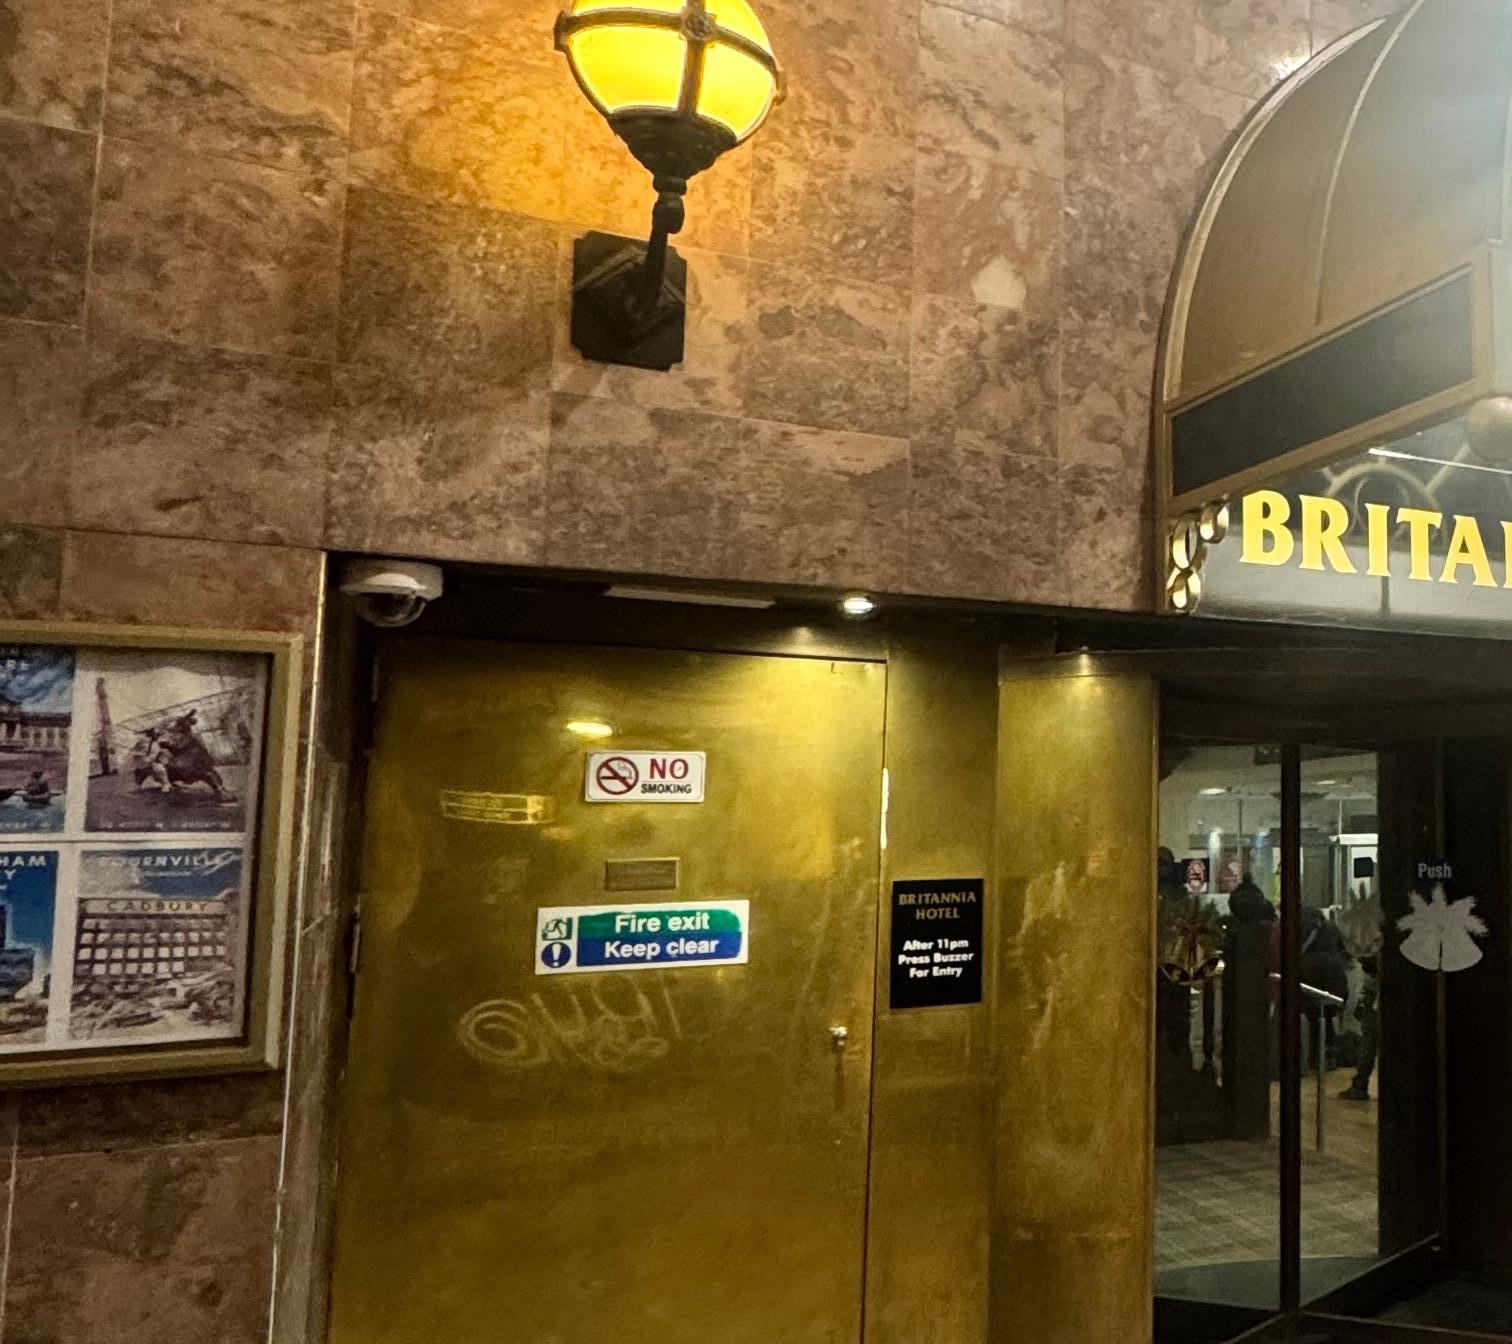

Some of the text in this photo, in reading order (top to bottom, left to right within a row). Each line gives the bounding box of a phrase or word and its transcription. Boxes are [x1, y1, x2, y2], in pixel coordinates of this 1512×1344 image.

[650, 758, 689, 779] NO
[641, 783, 692, 794] SMOKING
[1417, 862, 1452, 879] Push
[899, 892, 977, 906] BRITANNIA
[107, 901, 208, 912] CADBURY
[915, 908, 960, 920] HOTEL
[615, 912, 710, 934] Fire exit
[605, 937, 719, 960] Keep clear
[903, 938, 969, 951] After 11pm
[898, 952, 974, 965] Press Buzzer
[909, 966, 963, 978] For Entry
